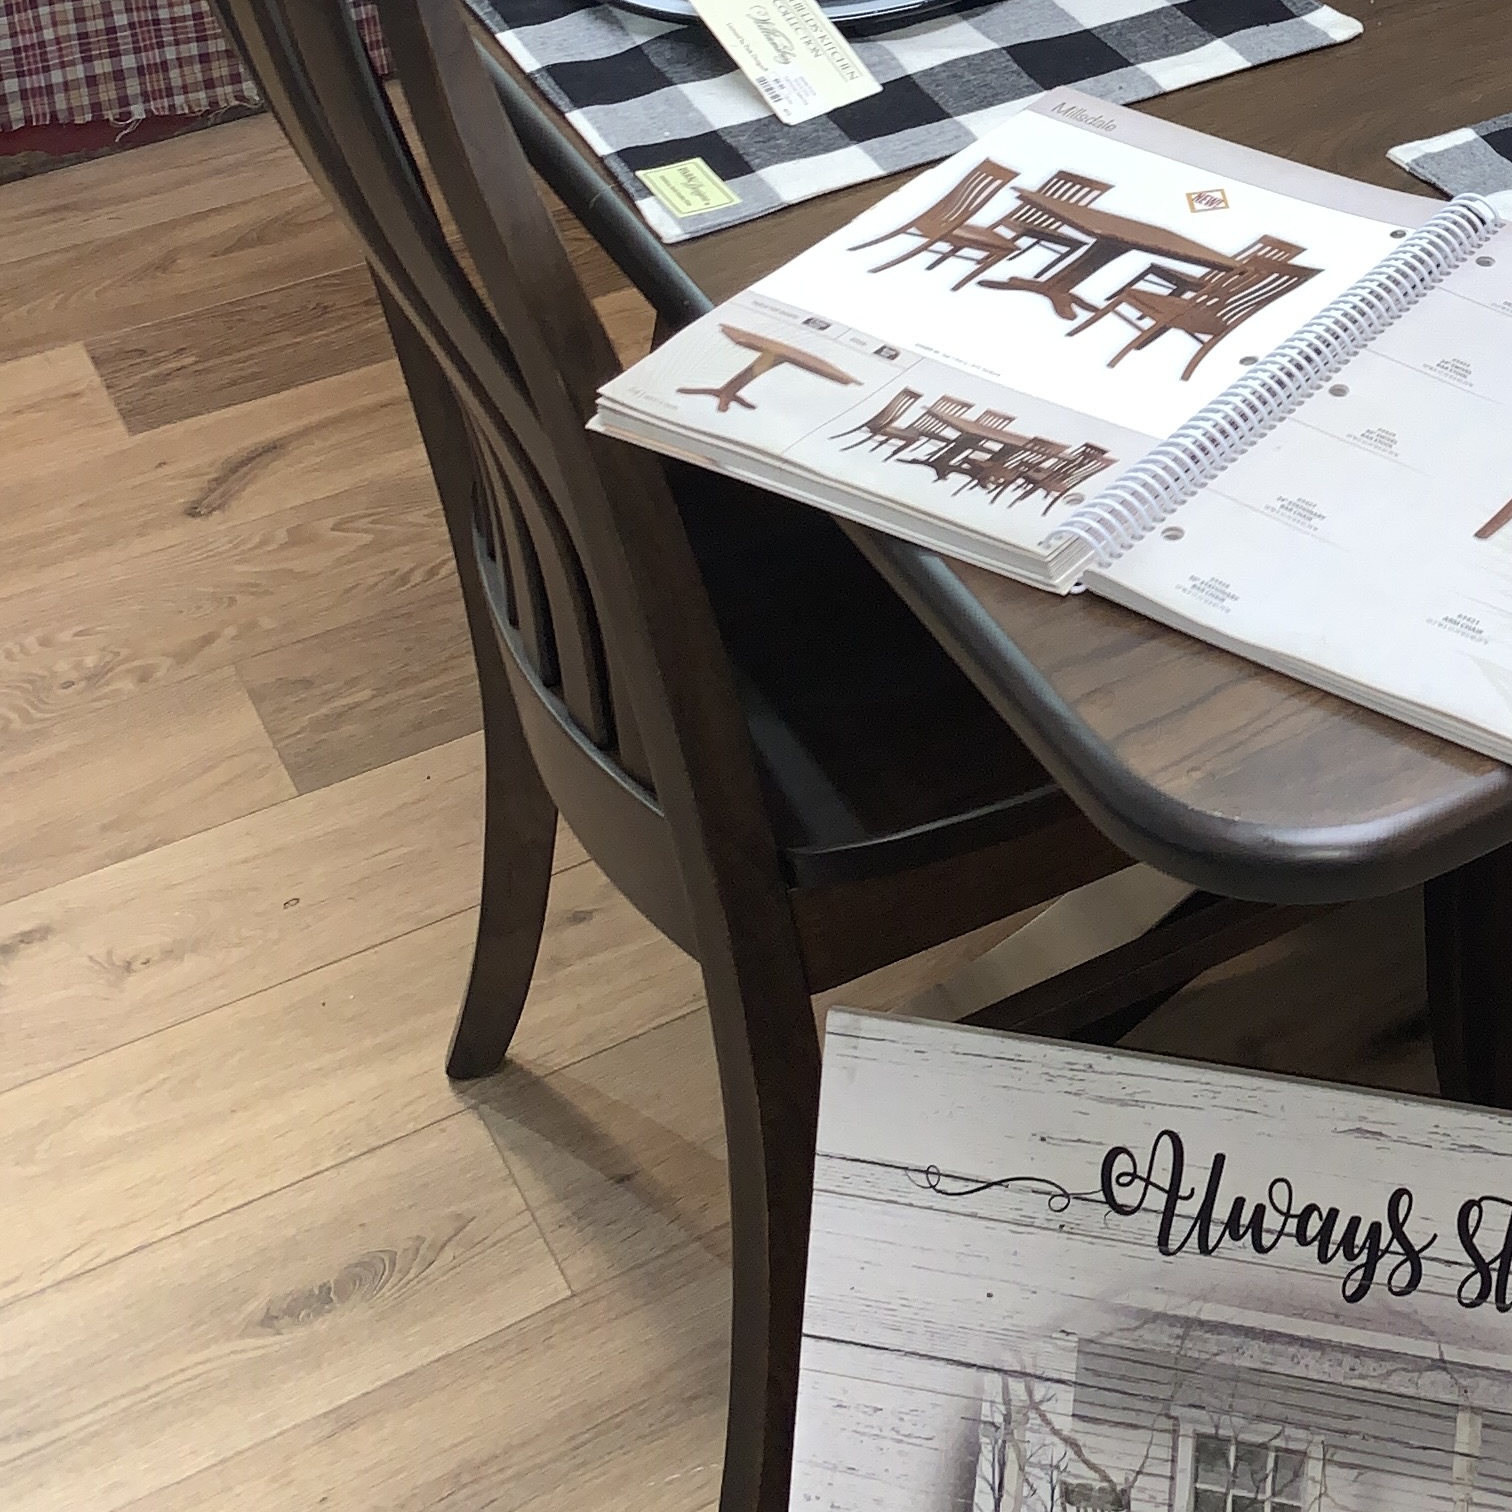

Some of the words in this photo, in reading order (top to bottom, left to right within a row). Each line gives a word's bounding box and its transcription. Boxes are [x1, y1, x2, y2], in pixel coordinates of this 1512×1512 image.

[819, 33, 859, 81] KITCHEN
[1051, 101, 1118, 132] Millsdale
[1192, 191, 1227, 210] NEW!
[1099, 1128, 1435, 1304] Always
